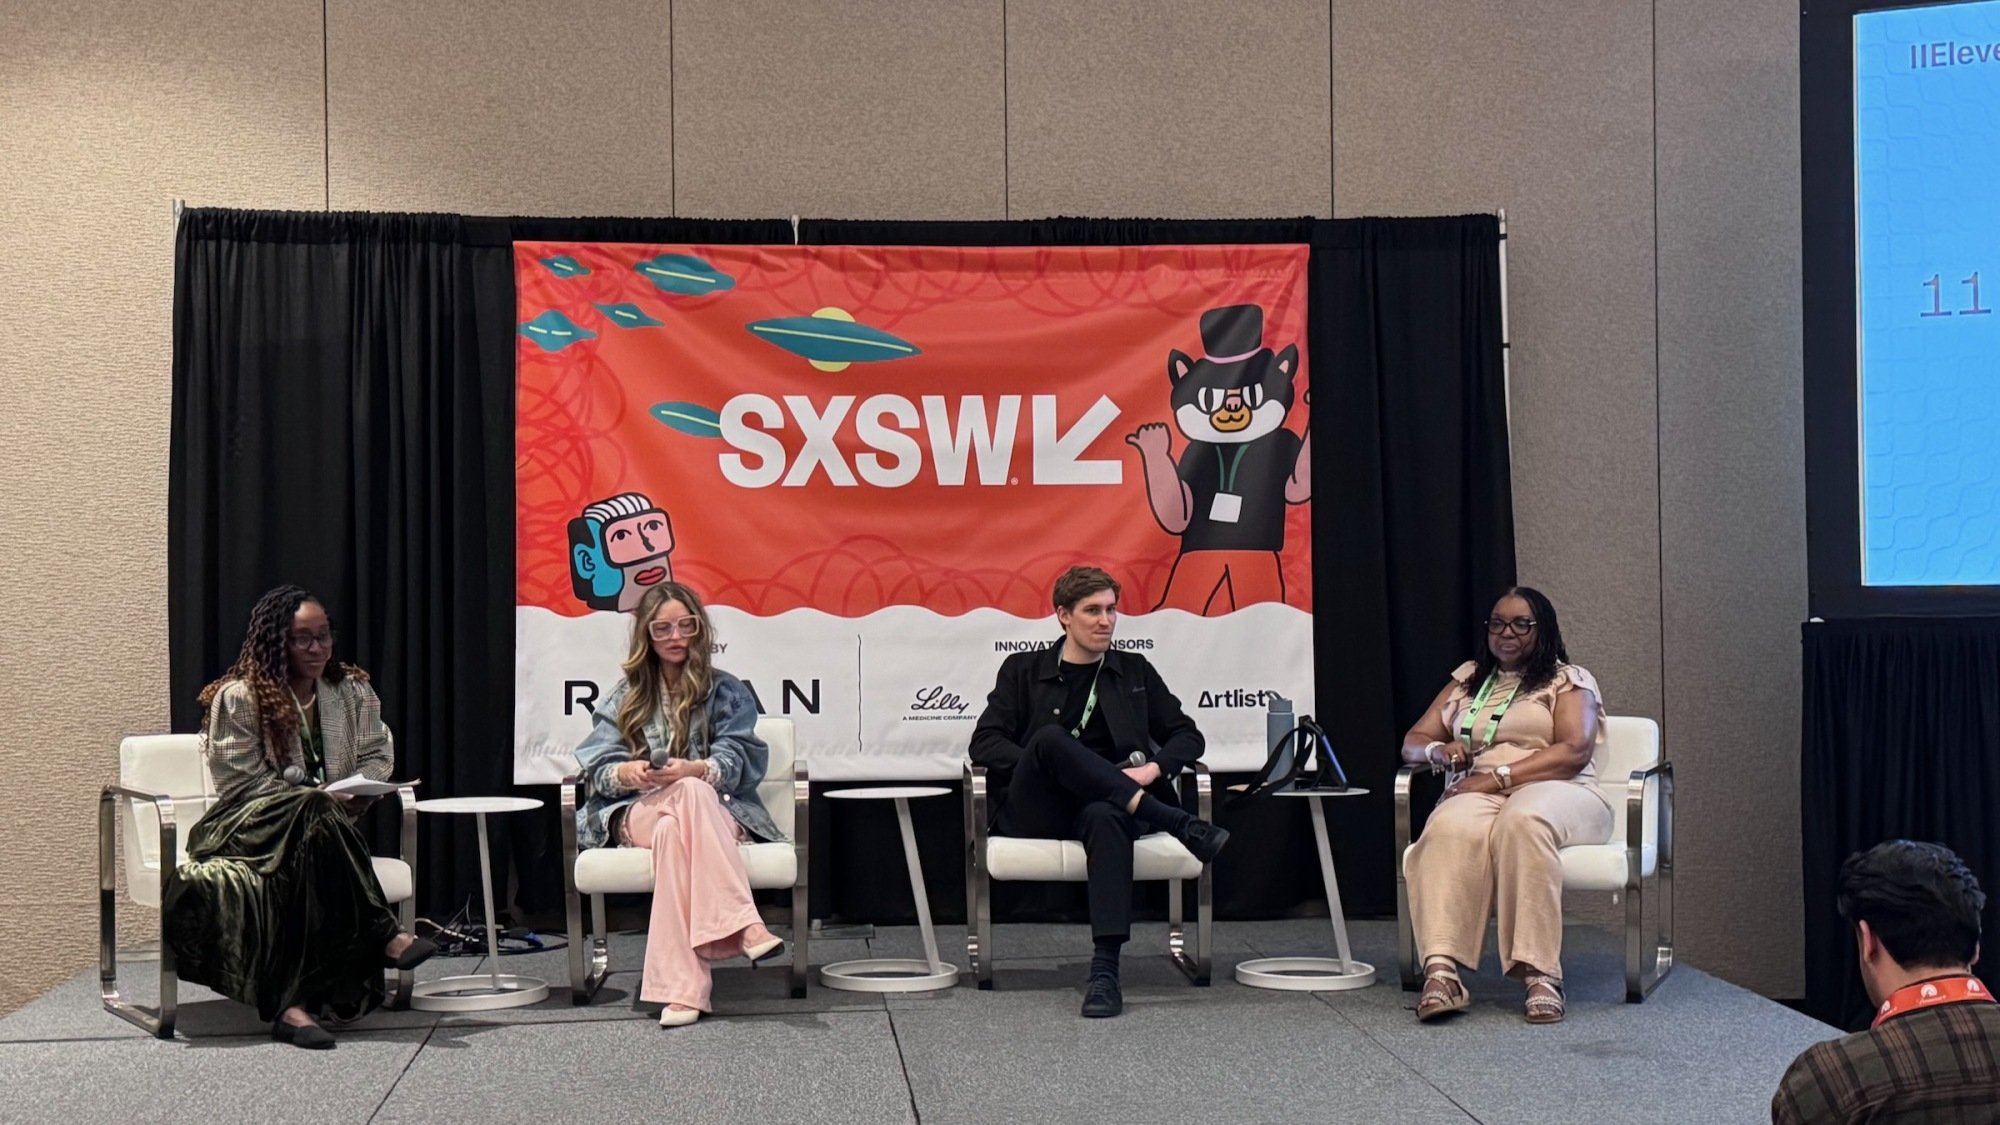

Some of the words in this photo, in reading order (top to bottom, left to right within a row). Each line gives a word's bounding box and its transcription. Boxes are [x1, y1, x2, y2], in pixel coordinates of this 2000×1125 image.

[1920, 272, 1991, 317] 11
[718, 393, 1022, 489] SXSW
[710, 643, 728, 654] BY
[995, 640, 1055, 652] INNOVAT
[1109, 639, 1154, 652] NSORS
[910, 685, 970, 714] Lilly
